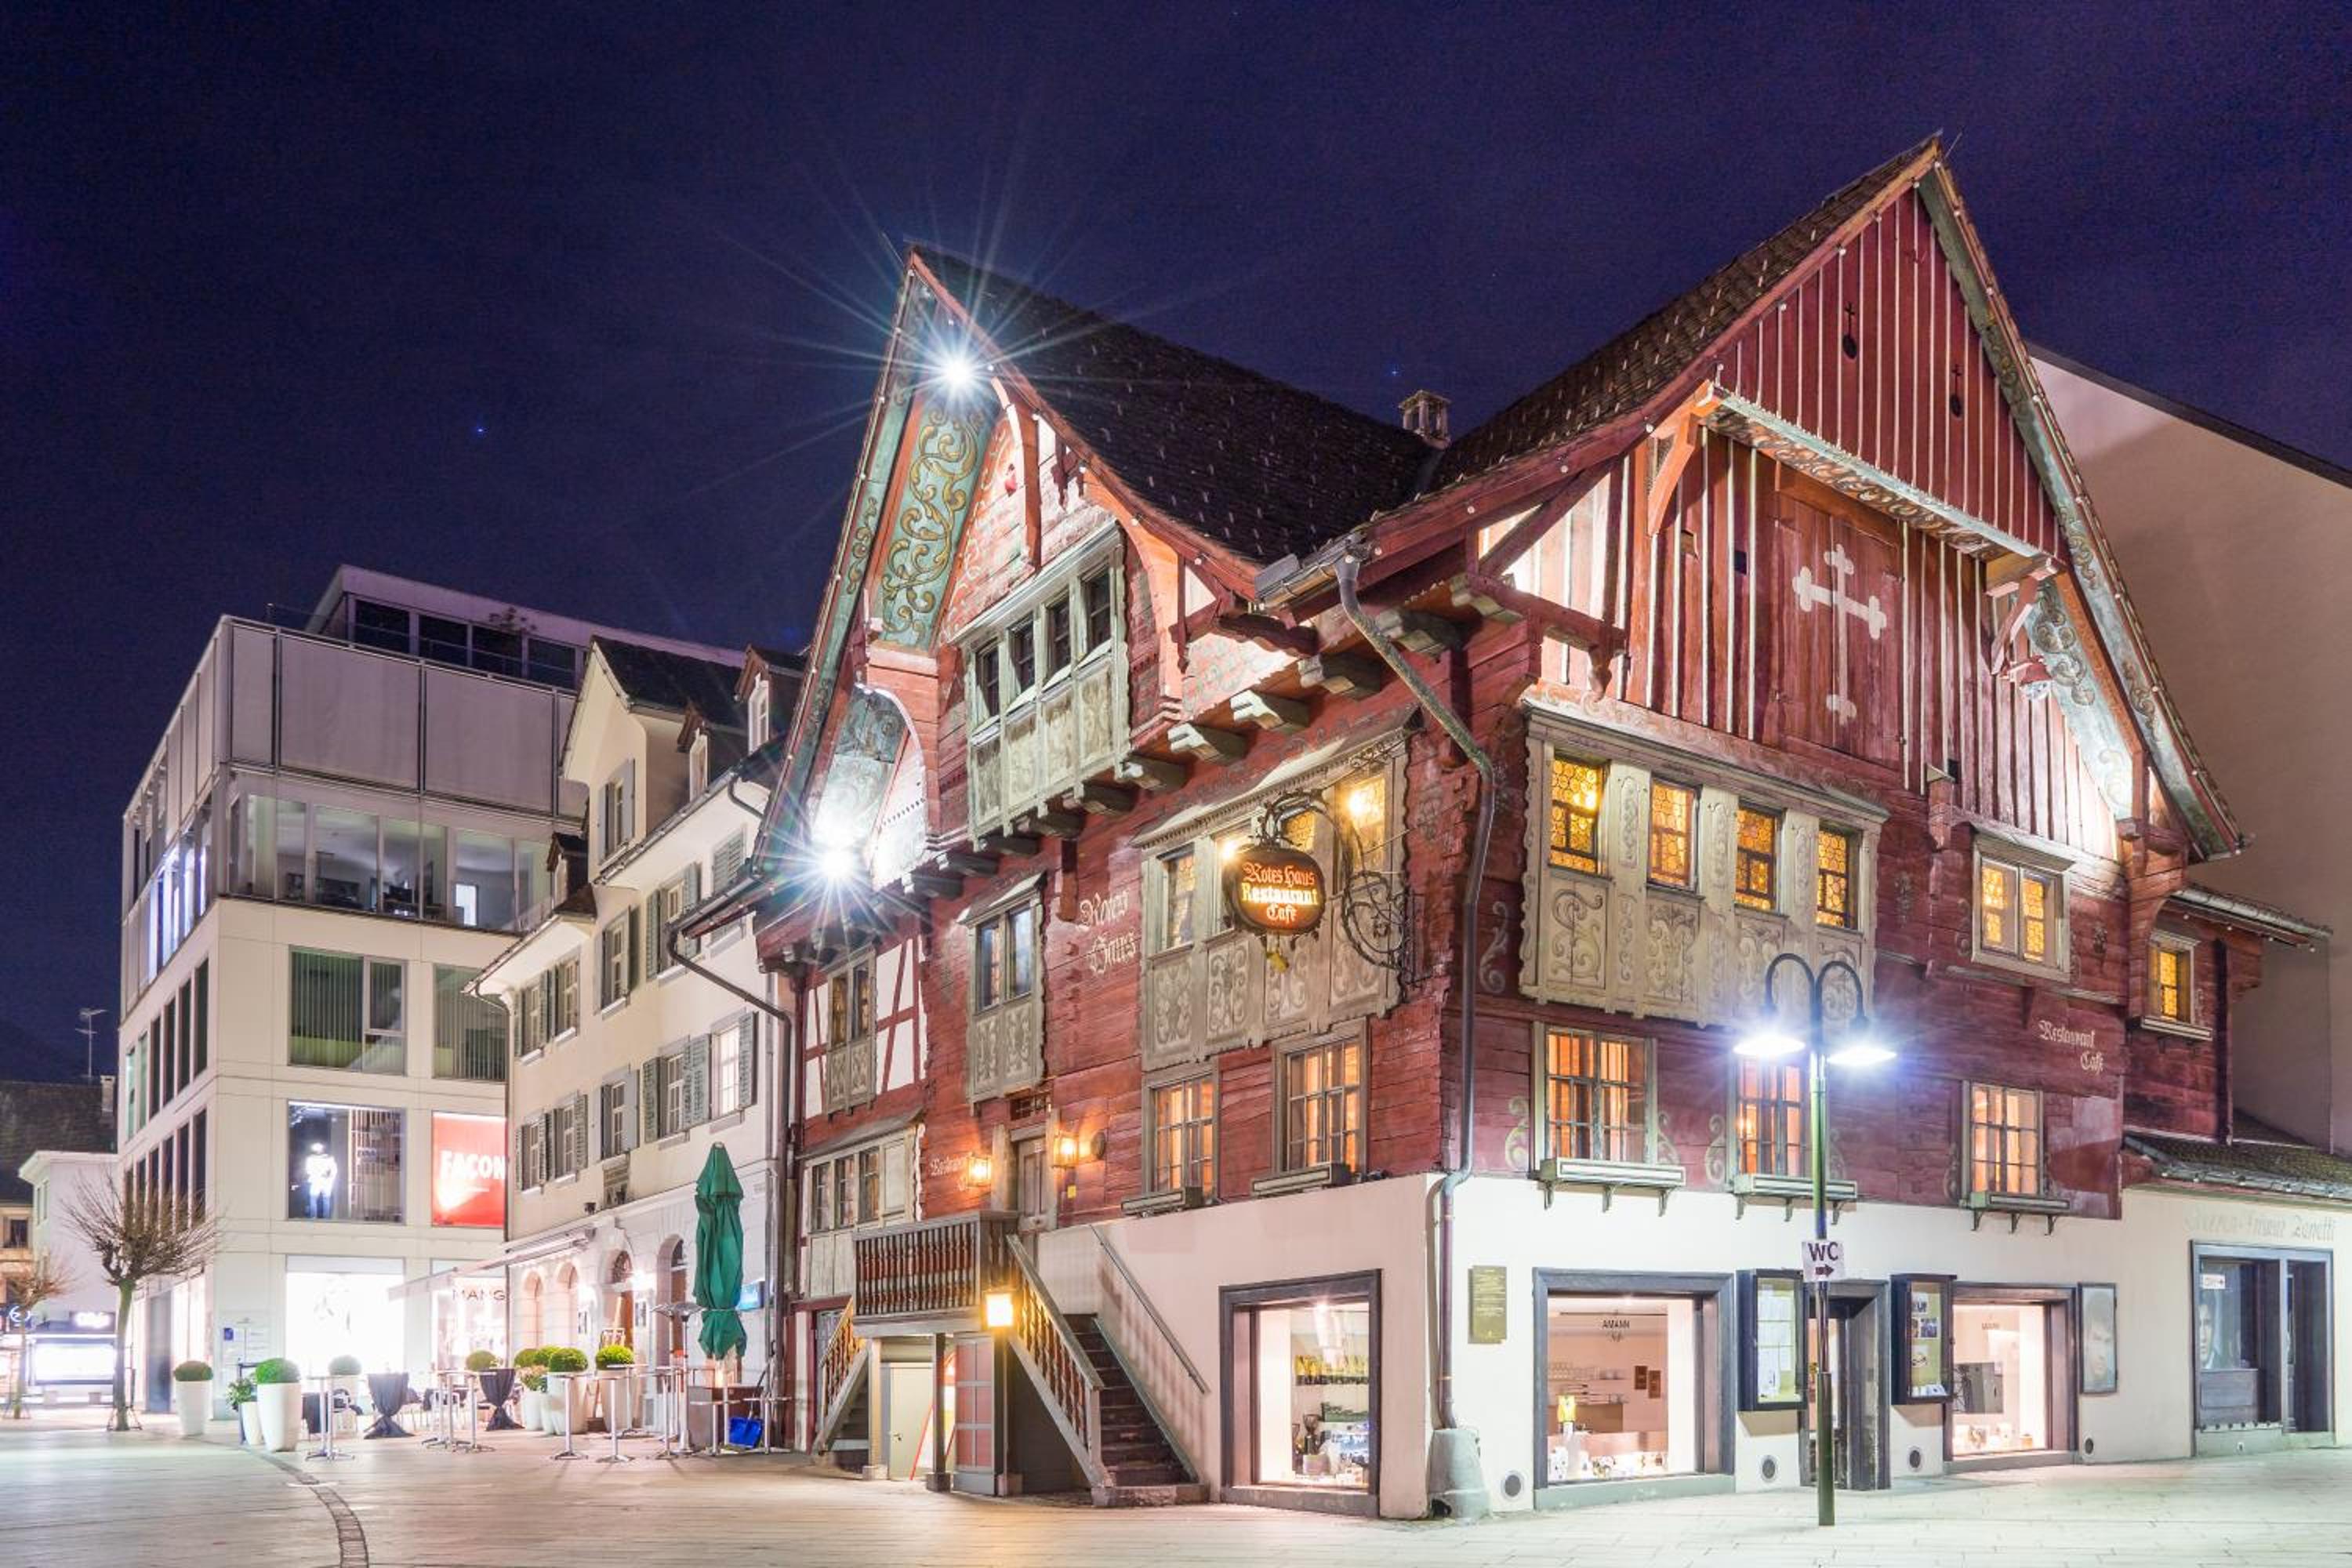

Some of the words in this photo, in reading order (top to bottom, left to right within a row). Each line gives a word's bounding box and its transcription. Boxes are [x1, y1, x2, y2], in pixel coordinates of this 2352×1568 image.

[1240, 862, 1283, 884] Rotes
[1240, 882, 1319, 905] Restaurant
[2038, 1020, 2096, 1048] Restaurant
[1807, 1242, 1838, 1261] WC
